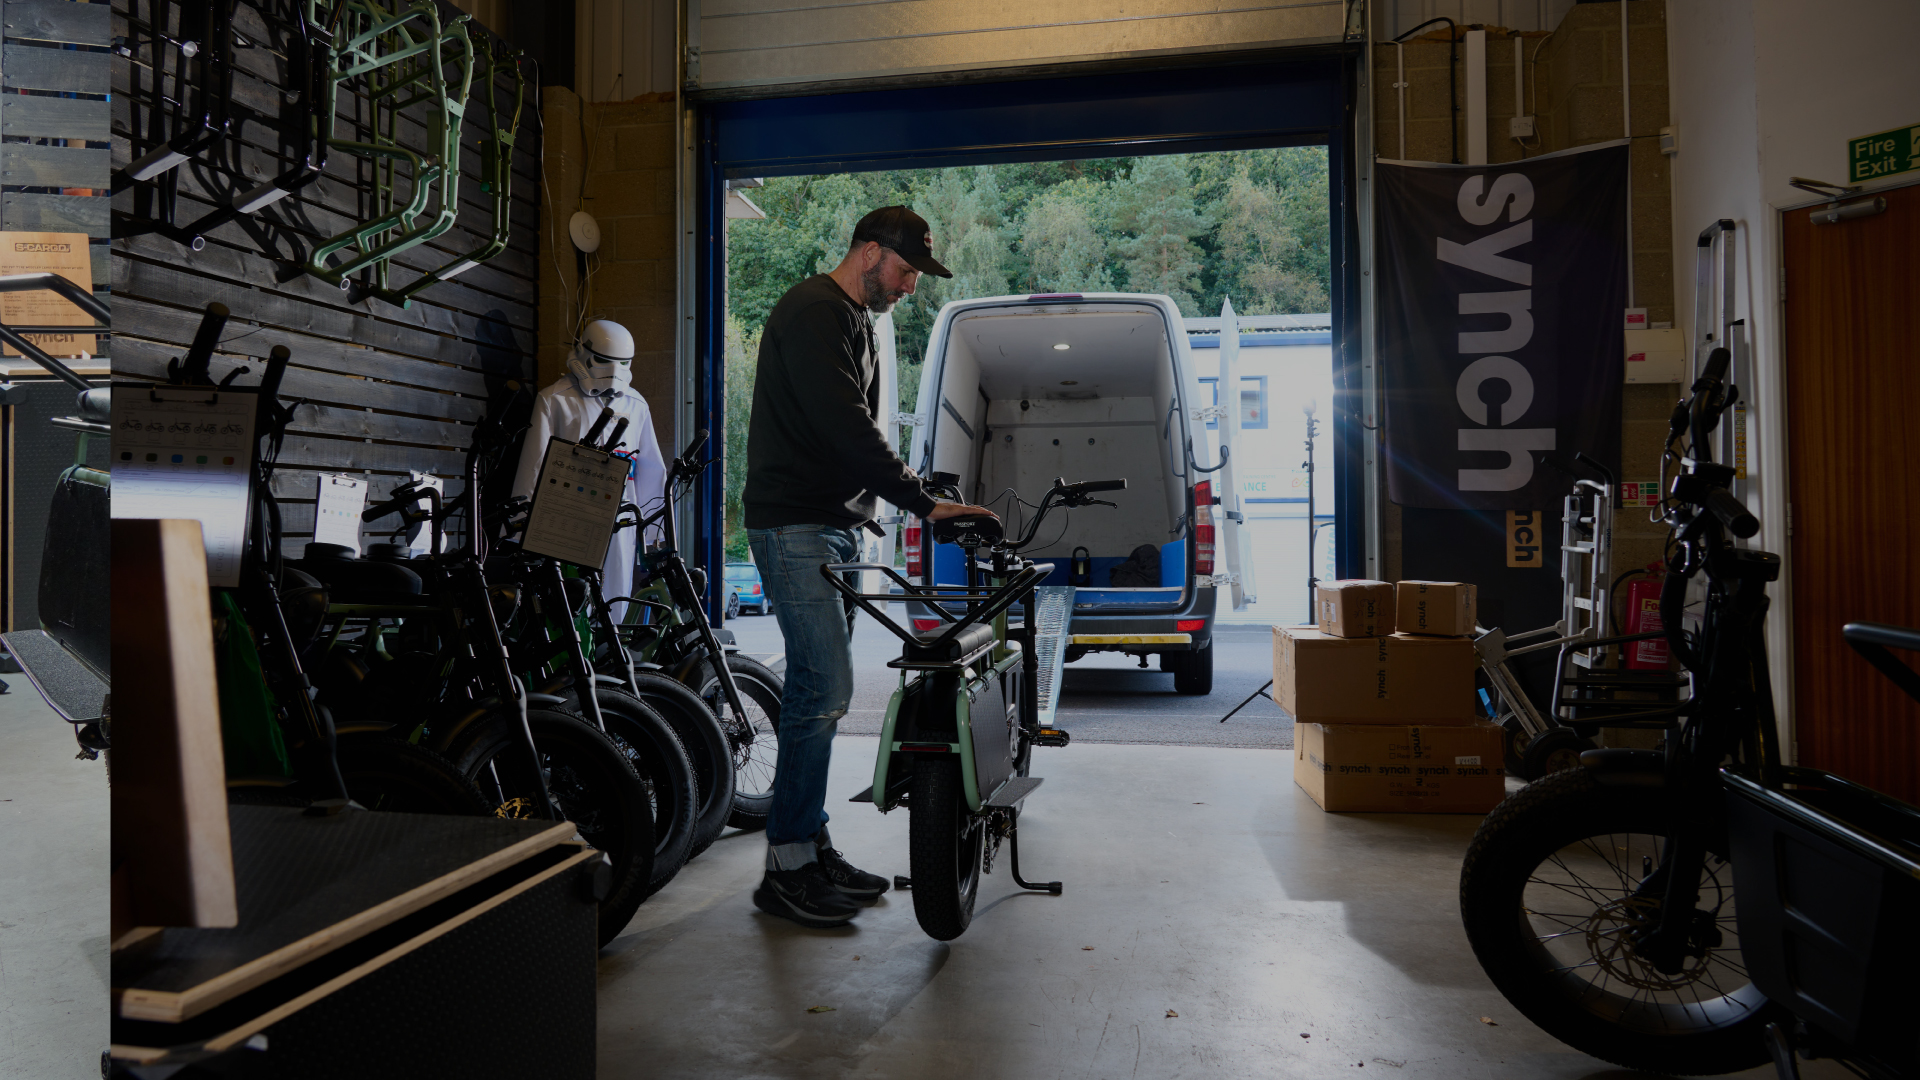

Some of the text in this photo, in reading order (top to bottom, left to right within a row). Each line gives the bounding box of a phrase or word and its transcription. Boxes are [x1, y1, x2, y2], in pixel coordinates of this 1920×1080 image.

[1855, 138, 1896, 159] Fire
[1855, 156, 1897, 178] Exit
[1437, 173, 1556, 492] synch
[1514, 510, 1540, 562] nch
[1417, 601, 1428, 629] synch
[1377, 670, 1388, 699] synch
[1411, 728, 1423, 758] synch
[1340, 764, 1371, 774] synch
[1379, 765, 1410, 775] synch
[1418, 766, 1449, 776] synch
[1457, 766, 1488, 776] synch
